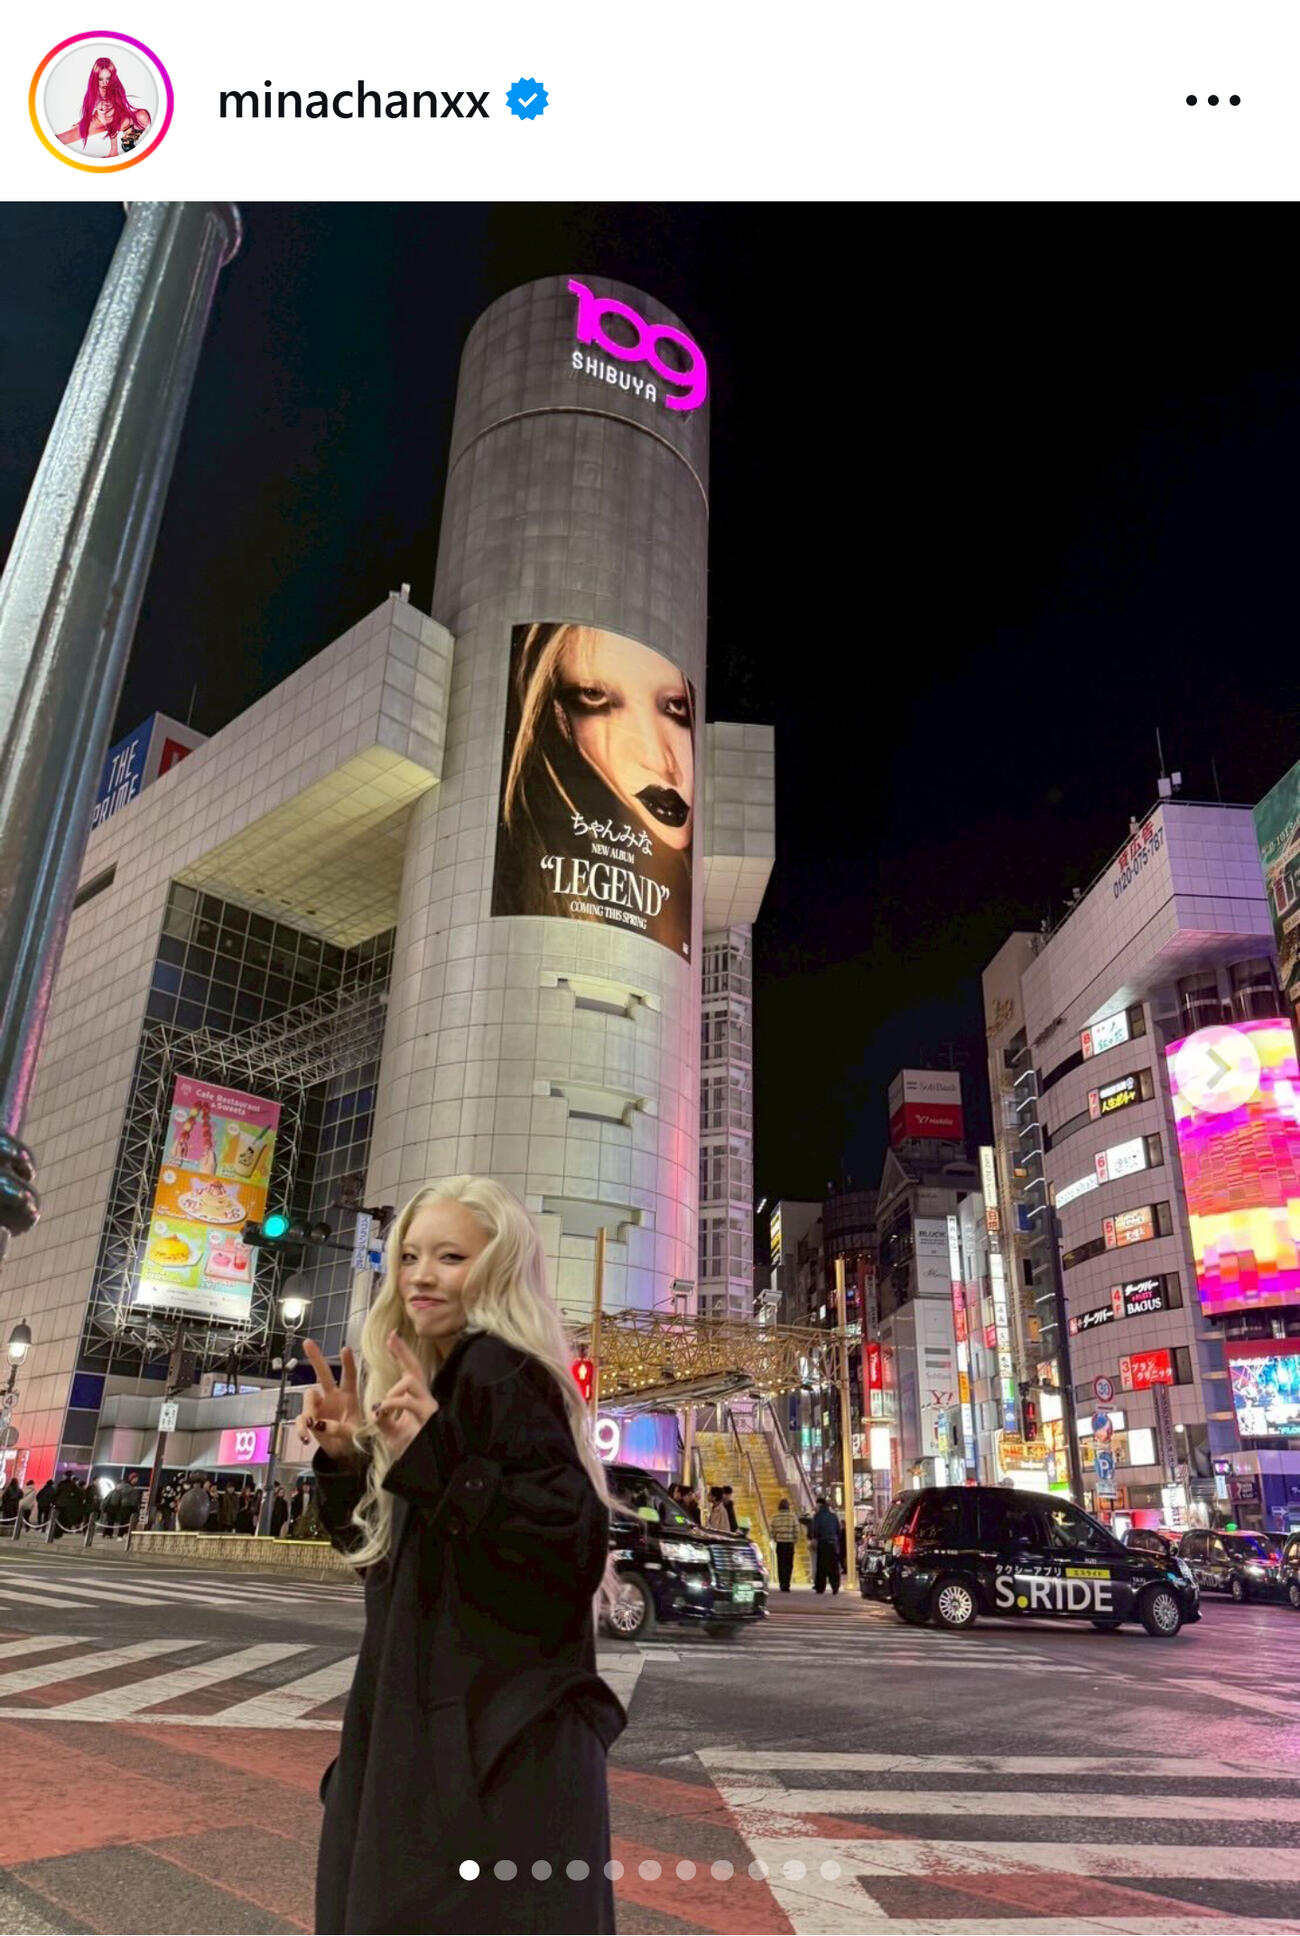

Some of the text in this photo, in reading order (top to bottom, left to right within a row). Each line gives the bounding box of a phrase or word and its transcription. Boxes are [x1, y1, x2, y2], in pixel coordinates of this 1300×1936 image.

[567, 279, 708, 411] 109
[572, 350, 657, 403] SHIBUYA
[107, 739, 139, 793] THE
[570, 812, 653, 856] ちゃんみな
[591, 842, 635, 864] NEW ALBUM
[570, 900, 648, 930] COMING THIS SPRING
[195, 1088, 260, 1113] Cafe Restaurant
[216, 1102, 246, 1116] Sweets
[1127, 1297, 1162, 1315] BAGUS
[994, 1564, 1062, 1577] タクシーアプリ
[995, 1575, 1114, 1612] S.RIDE
